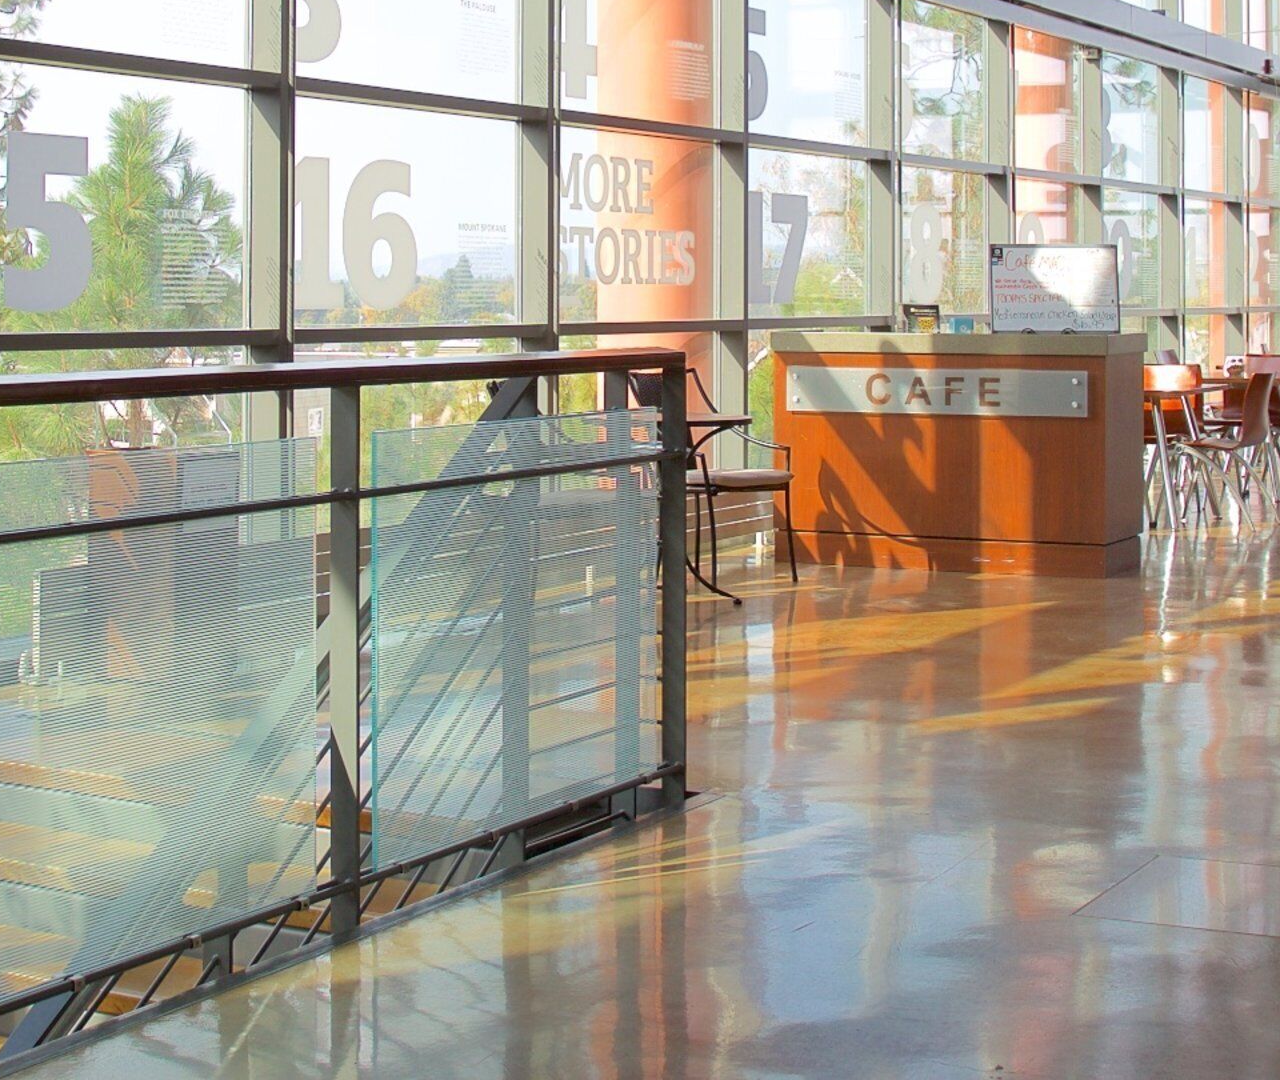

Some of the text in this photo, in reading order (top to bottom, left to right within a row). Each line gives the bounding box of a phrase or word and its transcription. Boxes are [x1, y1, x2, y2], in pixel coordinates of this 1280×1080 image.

[559, 154, 655, 215] MORE
[295, 156, 418, 311] 16
[747, 191, 809, 305] 17
[864, 371, 1003, 408] CAFE
